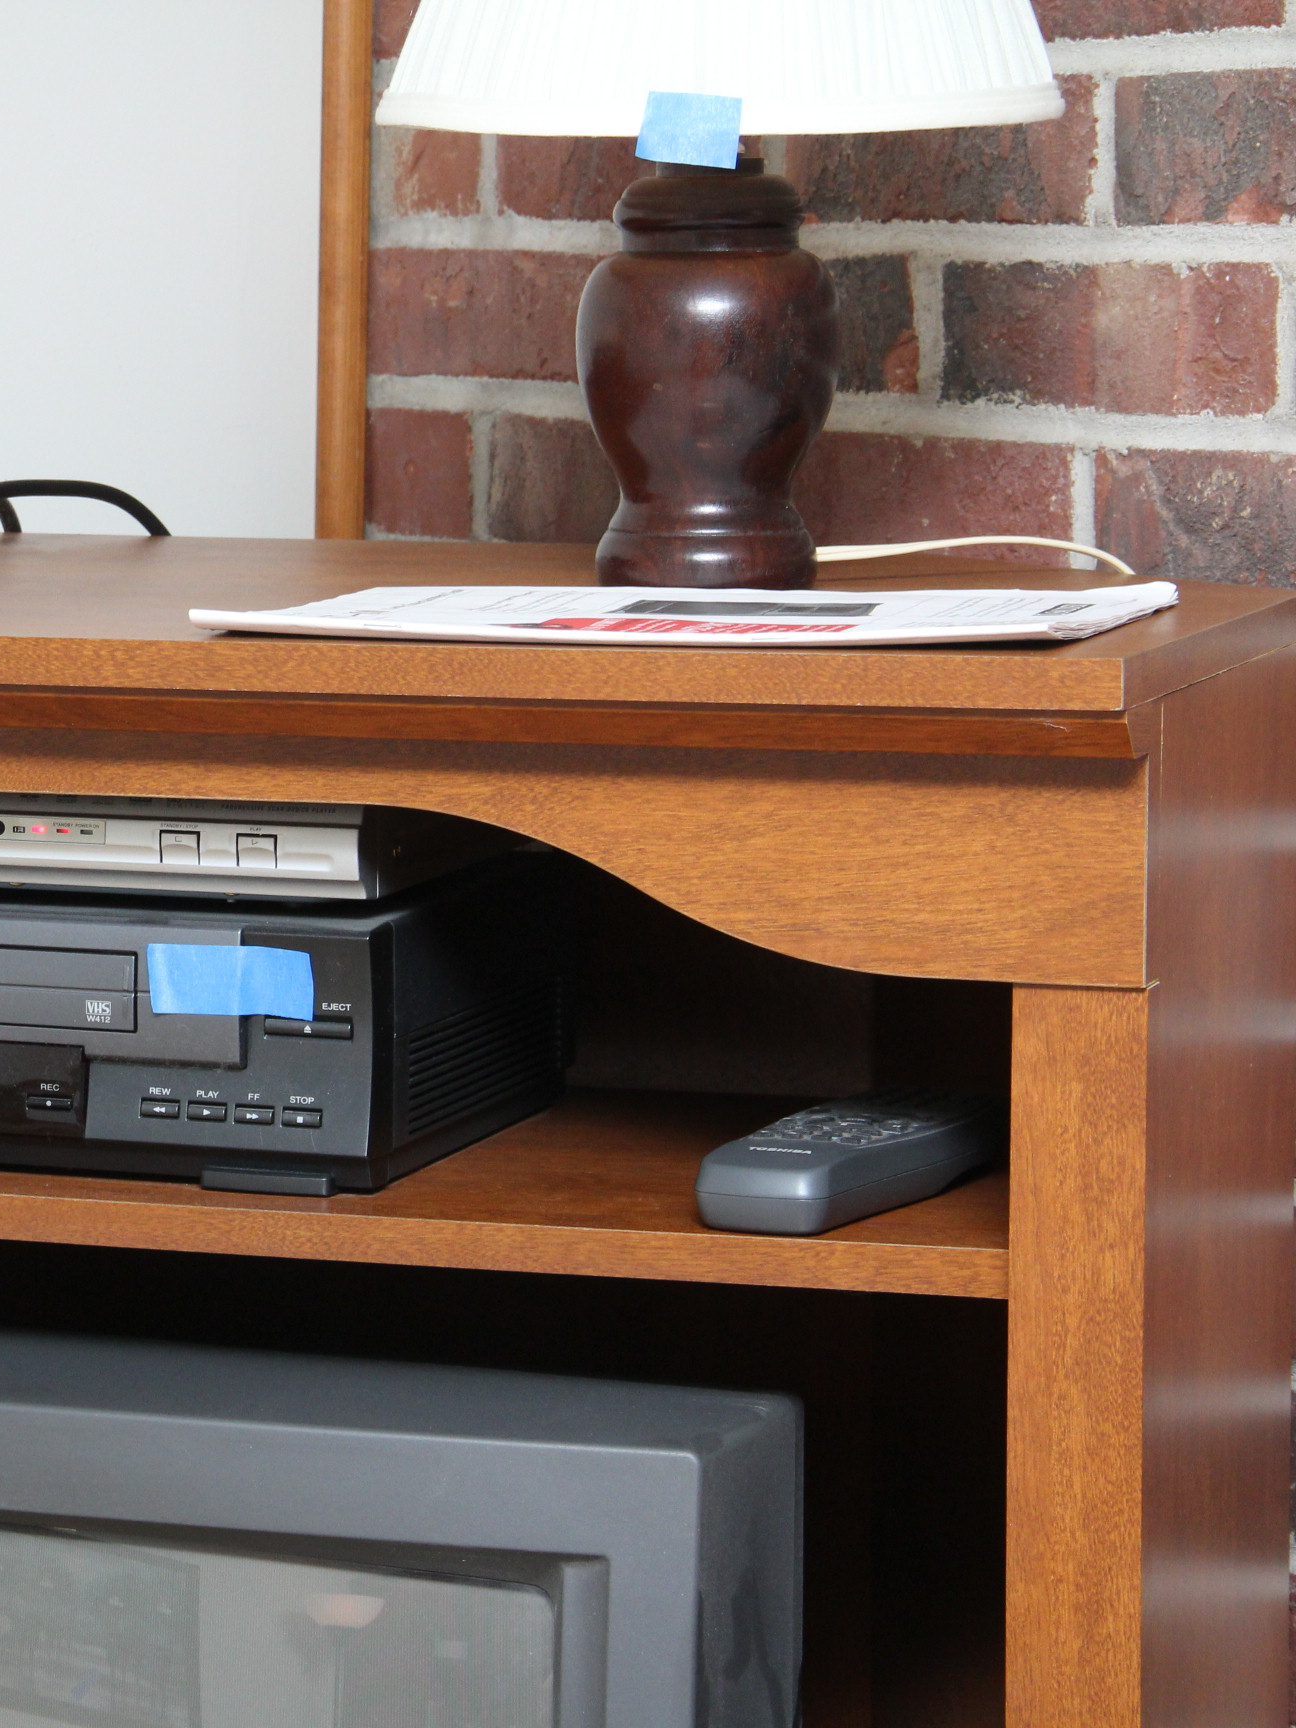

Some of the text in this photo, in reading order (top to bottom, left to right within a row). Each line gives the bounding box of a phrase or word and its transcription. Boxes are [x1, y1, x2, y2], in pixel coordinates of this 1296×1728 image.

[87, 1001, 110, 1014] VHS
[321, 1002, 352, 1011] EJECT
[86, 1014, 111, 1023] W412
[40, 1083, 60, 1091] REC
[149, 1087, 171, 1096] REW
[196, 1090, 219, 1099] PLAY
[248, 1093, 260, 1101] FF
[289, 1096, 314, 1105] STOP
